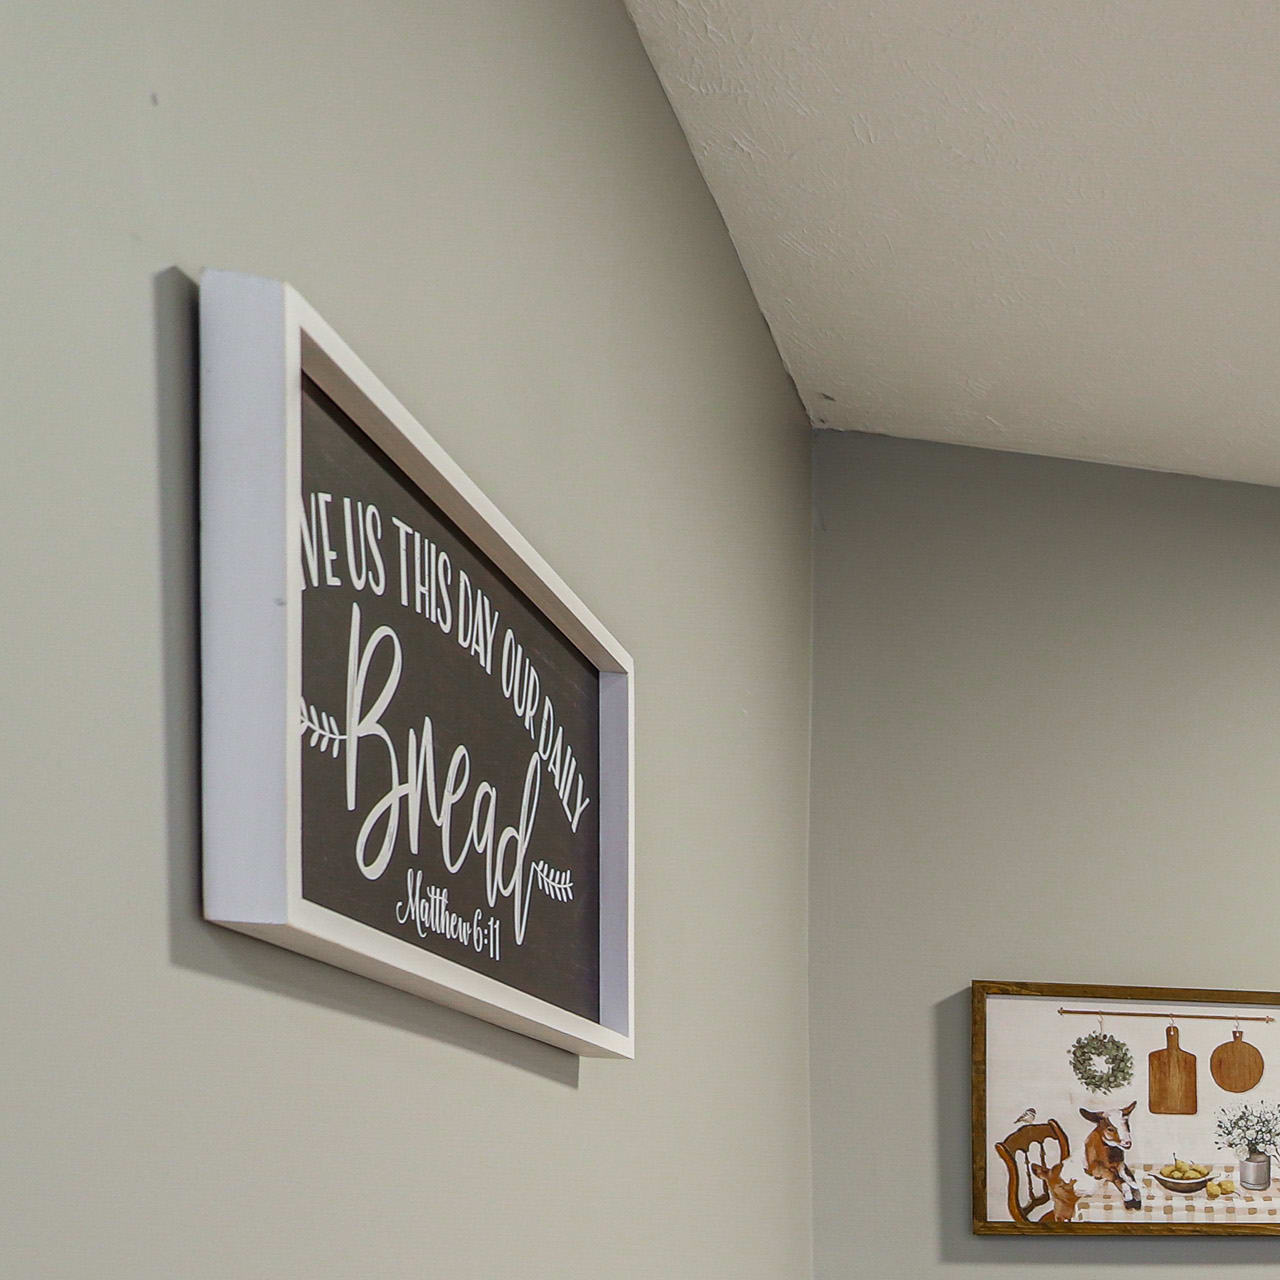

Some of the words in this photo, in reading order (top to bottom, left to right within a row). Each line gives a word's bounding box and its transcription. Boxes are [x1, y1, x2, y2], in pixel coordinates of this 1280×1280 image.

[344, 496, 386, 596] US
[391, 516, 453, 634] THIS
[458, 570, 500, 676] DAY
[501, 628, 541, 741] OUR
[538, 696, 591, 833] DAILY
[346, 602, 541, 947] Bread
[396, 868, 472, 946] Matthew
[473, 908, 500, 961] 6:11
